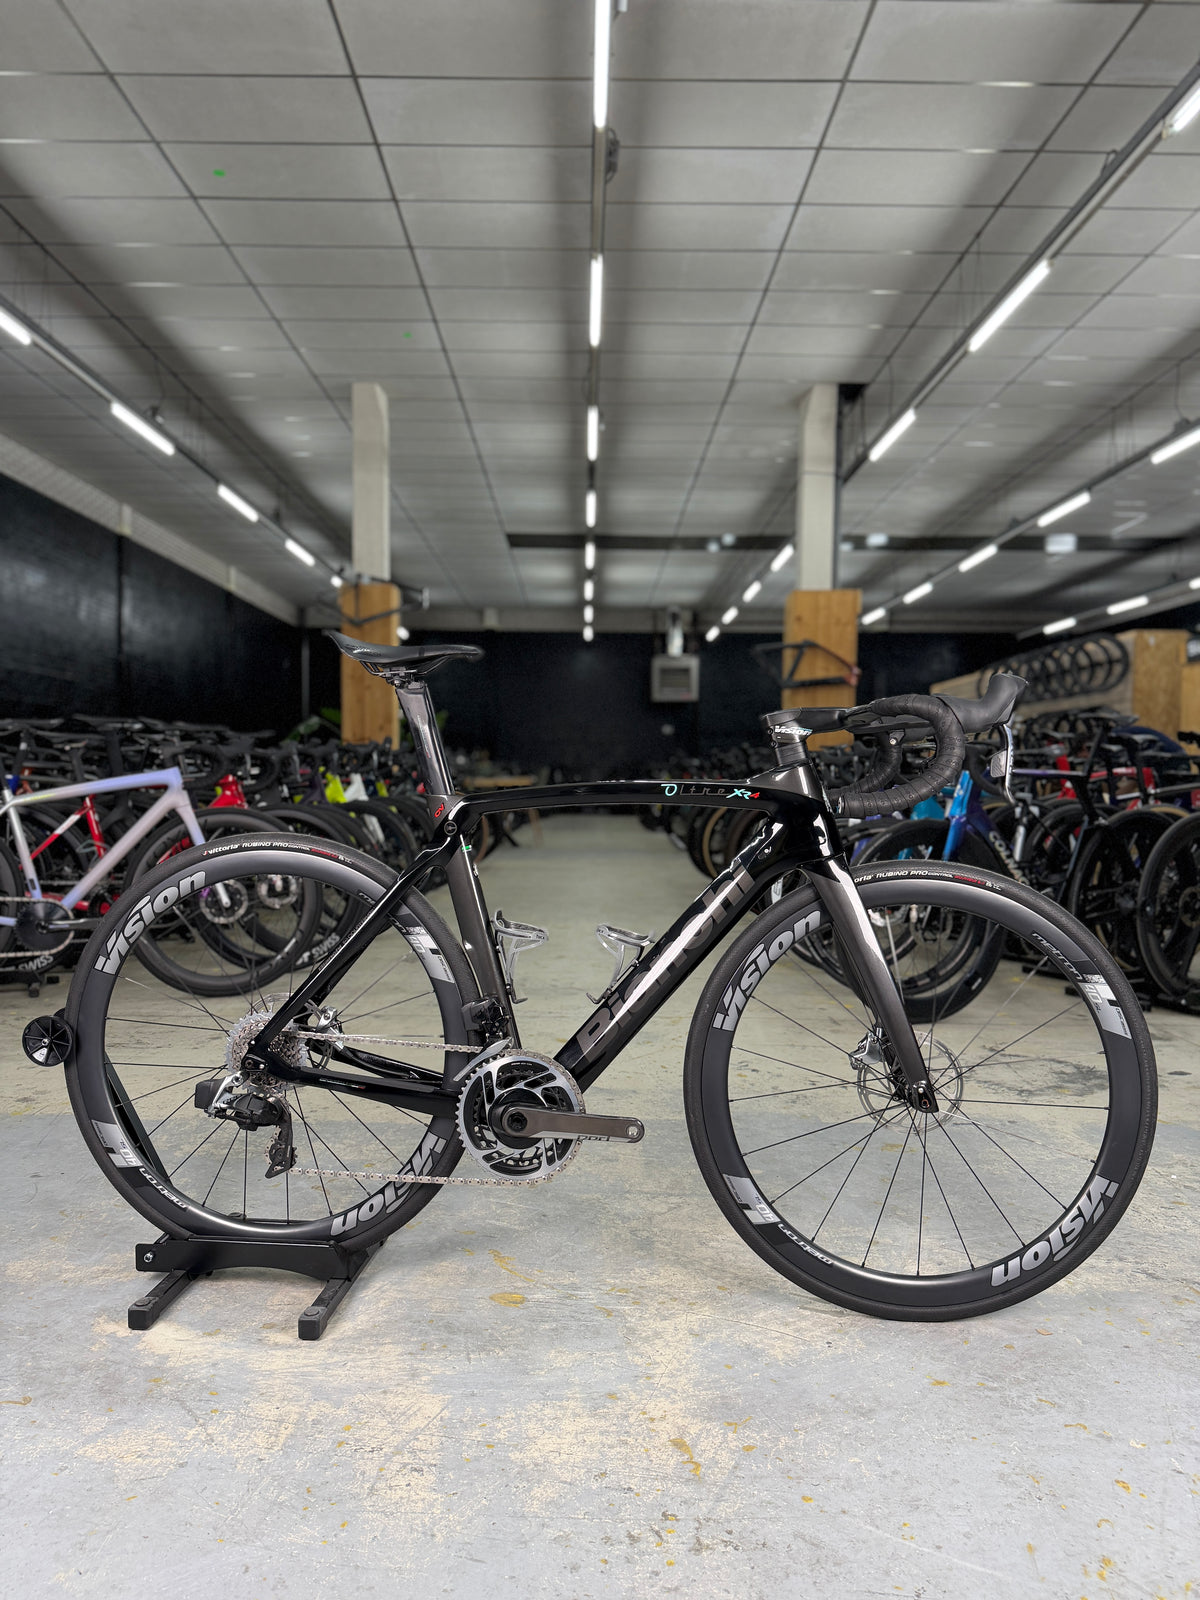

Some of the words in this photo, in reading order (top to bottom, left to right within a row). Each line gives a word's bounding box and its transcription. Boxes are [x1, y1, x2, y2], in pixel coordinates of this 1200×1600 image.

[774, 725, 813, 736] Vision
[726, 788, 760, 800] XR4
[854, 874, 874, 883] oria
[876, 870, 909, 878] RUBINO
[988, 830, 1031, 886] COLNAG
[94, 871, 206, 975] Vision
[712, 910, 821, 1032] Vision
[1031, 932, 1083, 980] metron
[138, 1167, 188, 1209] metron
[777, 1223, 833, 1265] metron
[990, 1173, 1120, 1287] Vision
